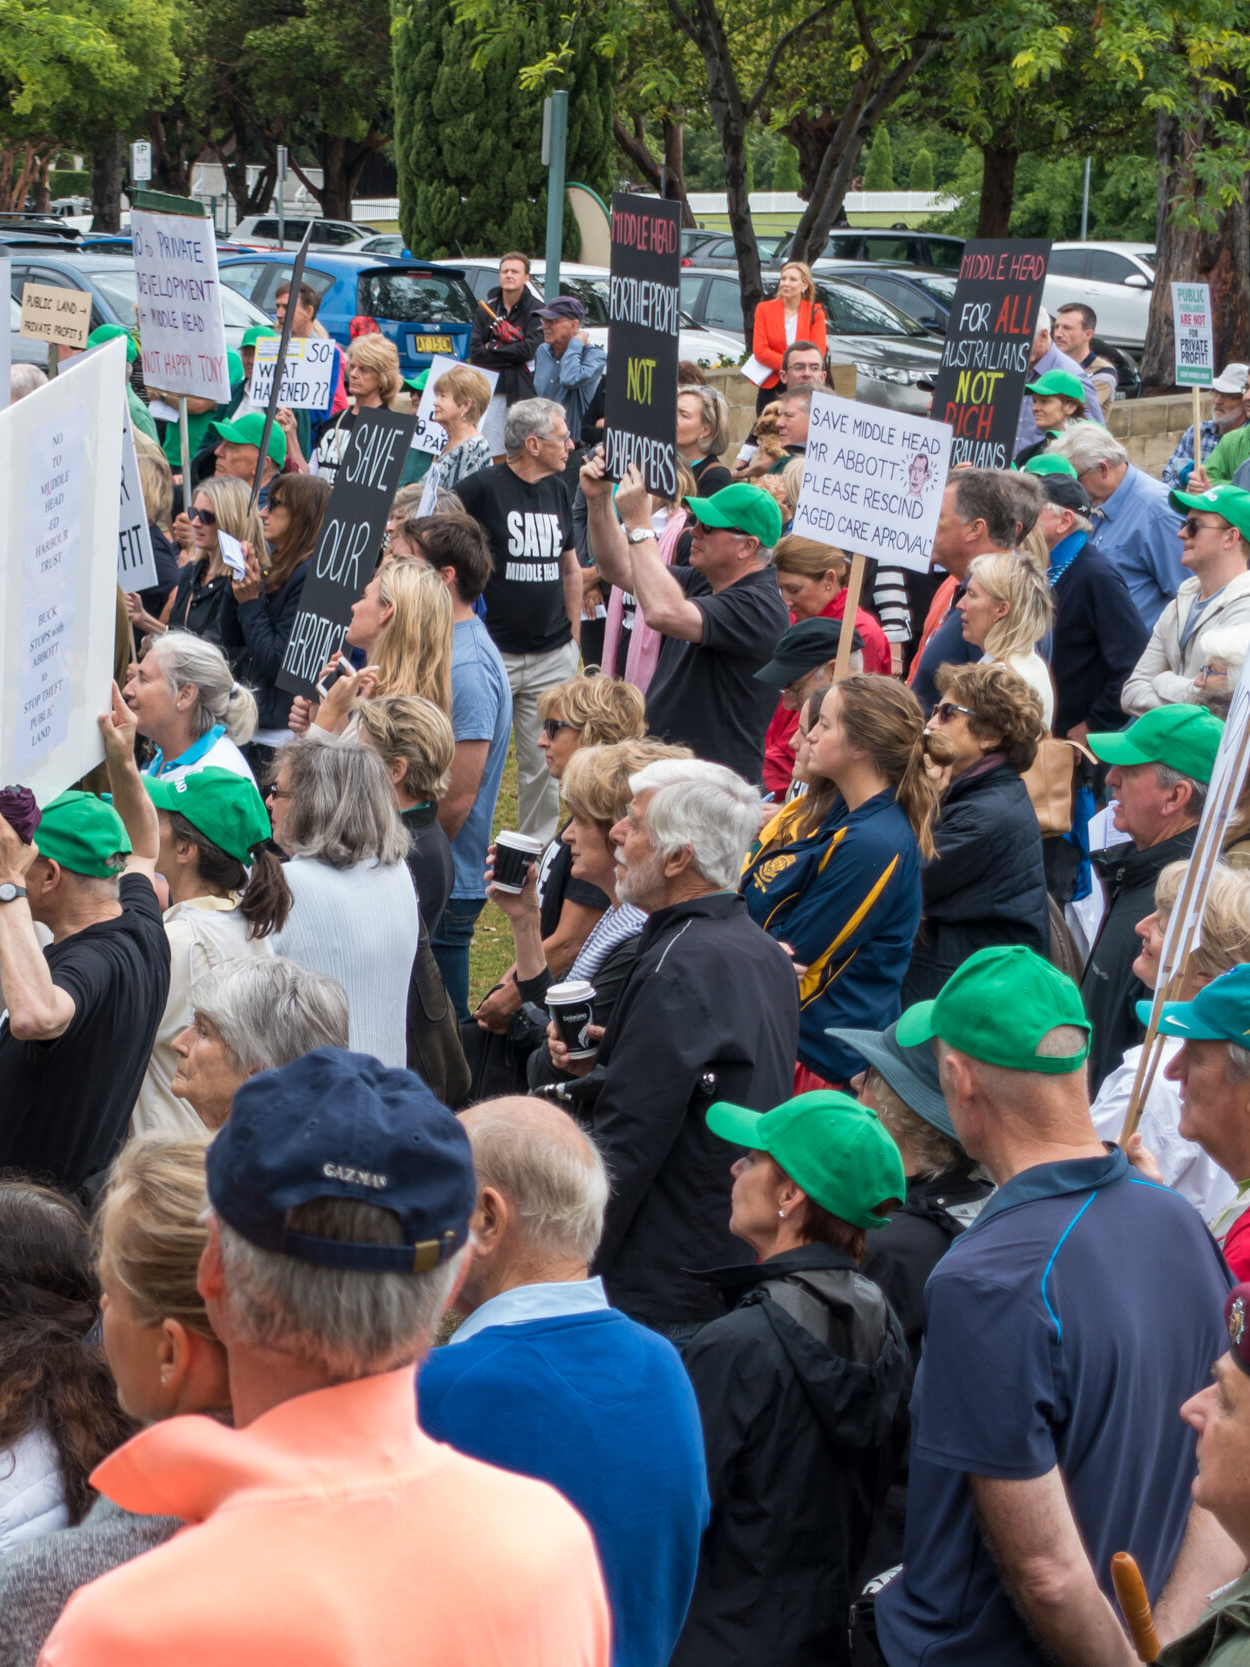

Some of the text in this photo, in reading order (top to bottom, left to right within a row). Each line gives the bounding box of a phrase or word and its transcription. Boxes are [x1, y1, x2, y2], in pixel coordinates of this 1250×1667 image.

[612, 211, 677, 254] MIDDLE HEAD
[157, 231, 203, 263] PRIVATE
[959, 253, 1045, 281] MIDDLE HEAD
[27, 294, 77, 314] PUBLIC LAND
[1177, 288, 1204, 303] PUBLIC
[151, 308, 178, 328] MIDDLE
[181, 312, 204, 332] HEAD
[959, 295, 1033, 334] FOR ALL
[1180, 313, 1206, 325] ARE NOT
[24, 320, 51, 335] PRIVATE
[1189, 329, 1198, 338] FOR
[942, 340, 1030, 372] AUSTRALIANS
[1180, 338, 1208, 353] PRIVATE
[143, 351, 223, 384] NOT HAPPY TONY
[259, 362, 299, 379] WAT
[1181, 352, 1208, 365] PROFIT!
[627, 356, 656, 406] NOT
[955, 370, 1004, 405] NOT
[52, 433, 63, 448] NO
[811, 407, 941, 455] SAVE MIDDLE HEAD
[52, 454, 62, 469] TO
[346, 424, 403, 491] SAVE
[808, 440, 900, 481] MR ABBOTT
[41, 470, 70, 496] MUDDLE
[45, 493, 64, 513] HEAD
[802, 472, 924, 520] PLEASE RESCIND
[507, 510, 563, 558] SAVE
[838, 516, 870, 541] CARE
[35, 529, 69, 558] HARBOUR
[316, 519, 370, 590] OUR
[40, 552, 62, 573] TRUST
[505, 562, 543, 582] MIDDLE
[38, 604, 58, 626] BUCK
[30, 622, 64, 652] STOPS with
[31, 642, 60, 669] ABBOTT
[41, 672, 48, 683] to
[24, 680, 63, 714] STOP THEFT
[30, 705, 54, 730] PUBLIC
[31, 725, 51, 747] LAND
